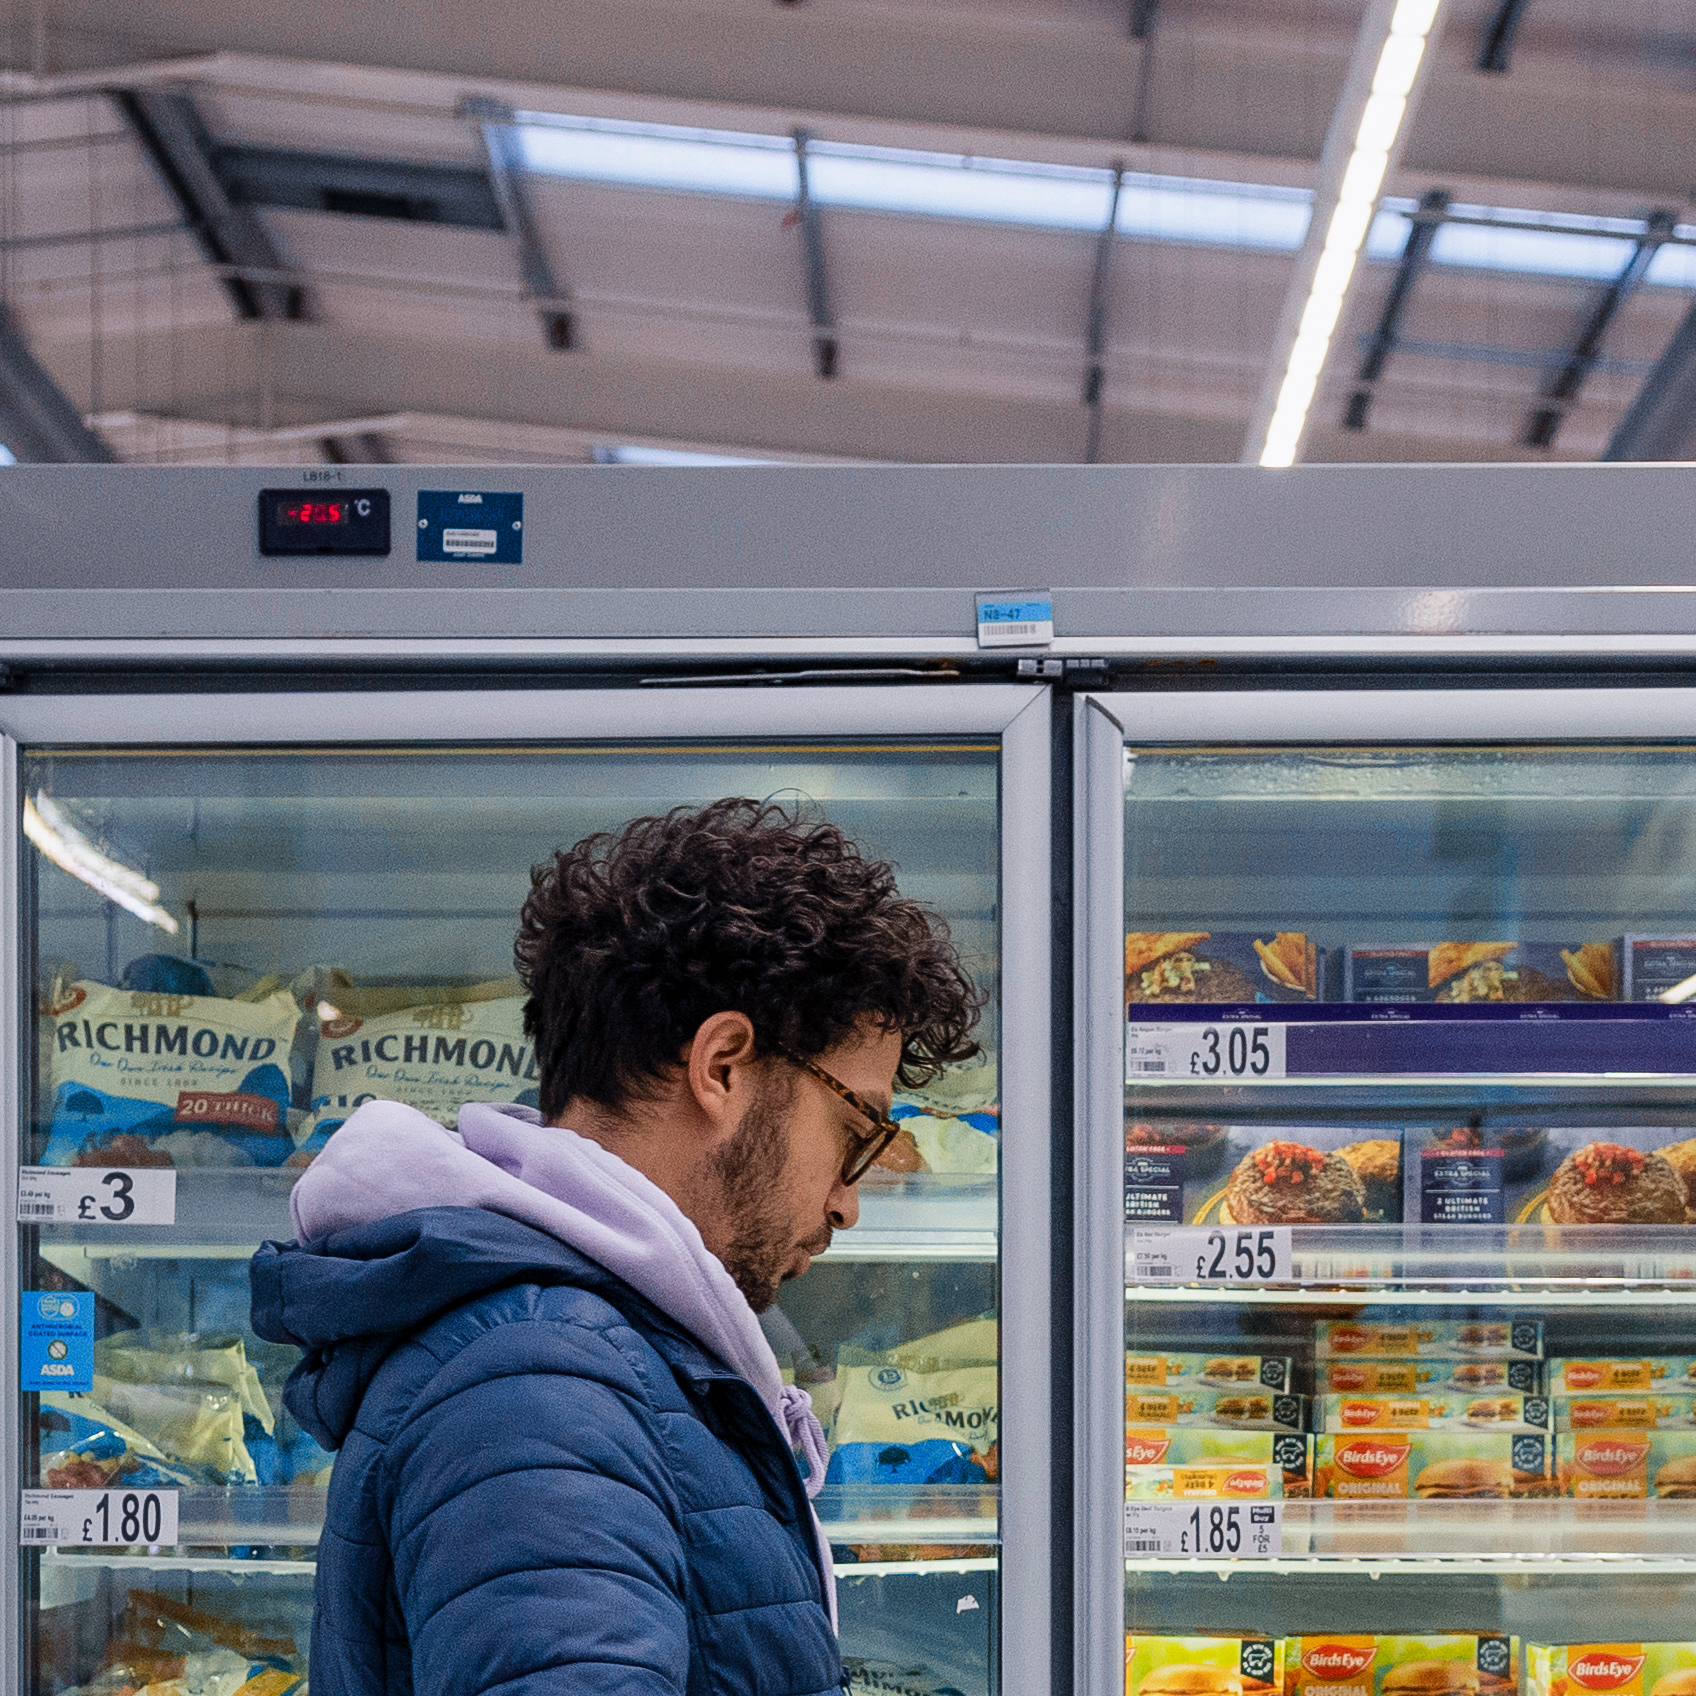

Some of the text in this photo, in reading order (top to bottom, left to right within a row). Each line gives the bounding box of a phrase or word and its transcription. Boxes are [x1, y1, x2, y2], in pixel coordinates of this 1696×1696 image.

[56, 1018, 280, 1062] RICHMOND
[1190, 1027, 1271, 1076] £3.05
[179, 1099, 208, 1115] 20
[78, 1171, 135, 1220] £3
[1196, 1230, 1276, 1279] £2.55
[40, 1364, 75, 1376] ASDA
[1338, 1483, 1402, 1496] ORIGINAL
[1578, 1481, 1642, 1493] ORIGINAL
[82, 1493, 162, 1543] £1.80
[1180, 1506, 1241, 1552] £1.85
[1252, 1534, 1271, 1544] FOR
[1258, 1543, 1269, 1553] £5
